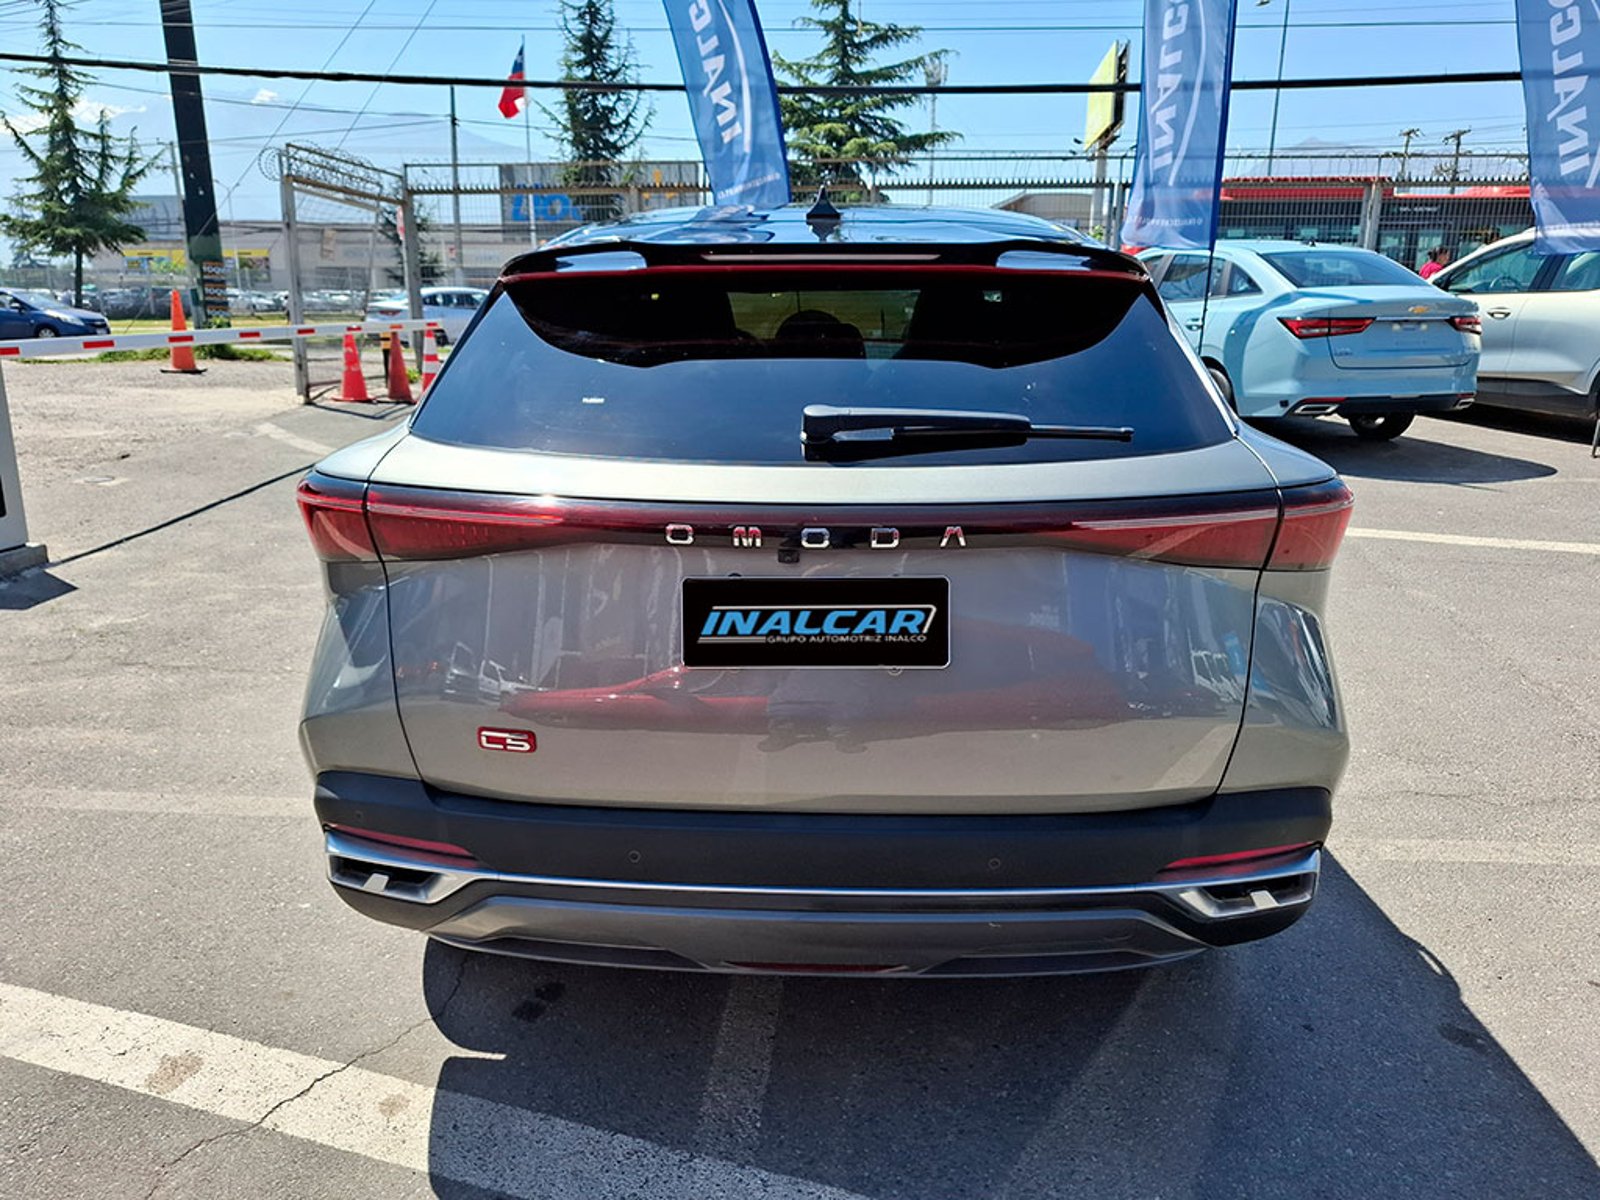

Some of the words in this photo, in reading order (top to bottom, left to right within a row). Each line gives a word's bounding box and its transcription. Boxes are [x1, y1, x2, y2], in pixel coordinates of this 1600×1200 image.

[665, 524, 966, 548] OMODA
[701, 609, 926, 635] INALCAR
[767, 635, 806, 643] GRUPO
[809, 635, 882, 643] AUTOMOTRIZ
[885, 635, 927, 643] INALCO
